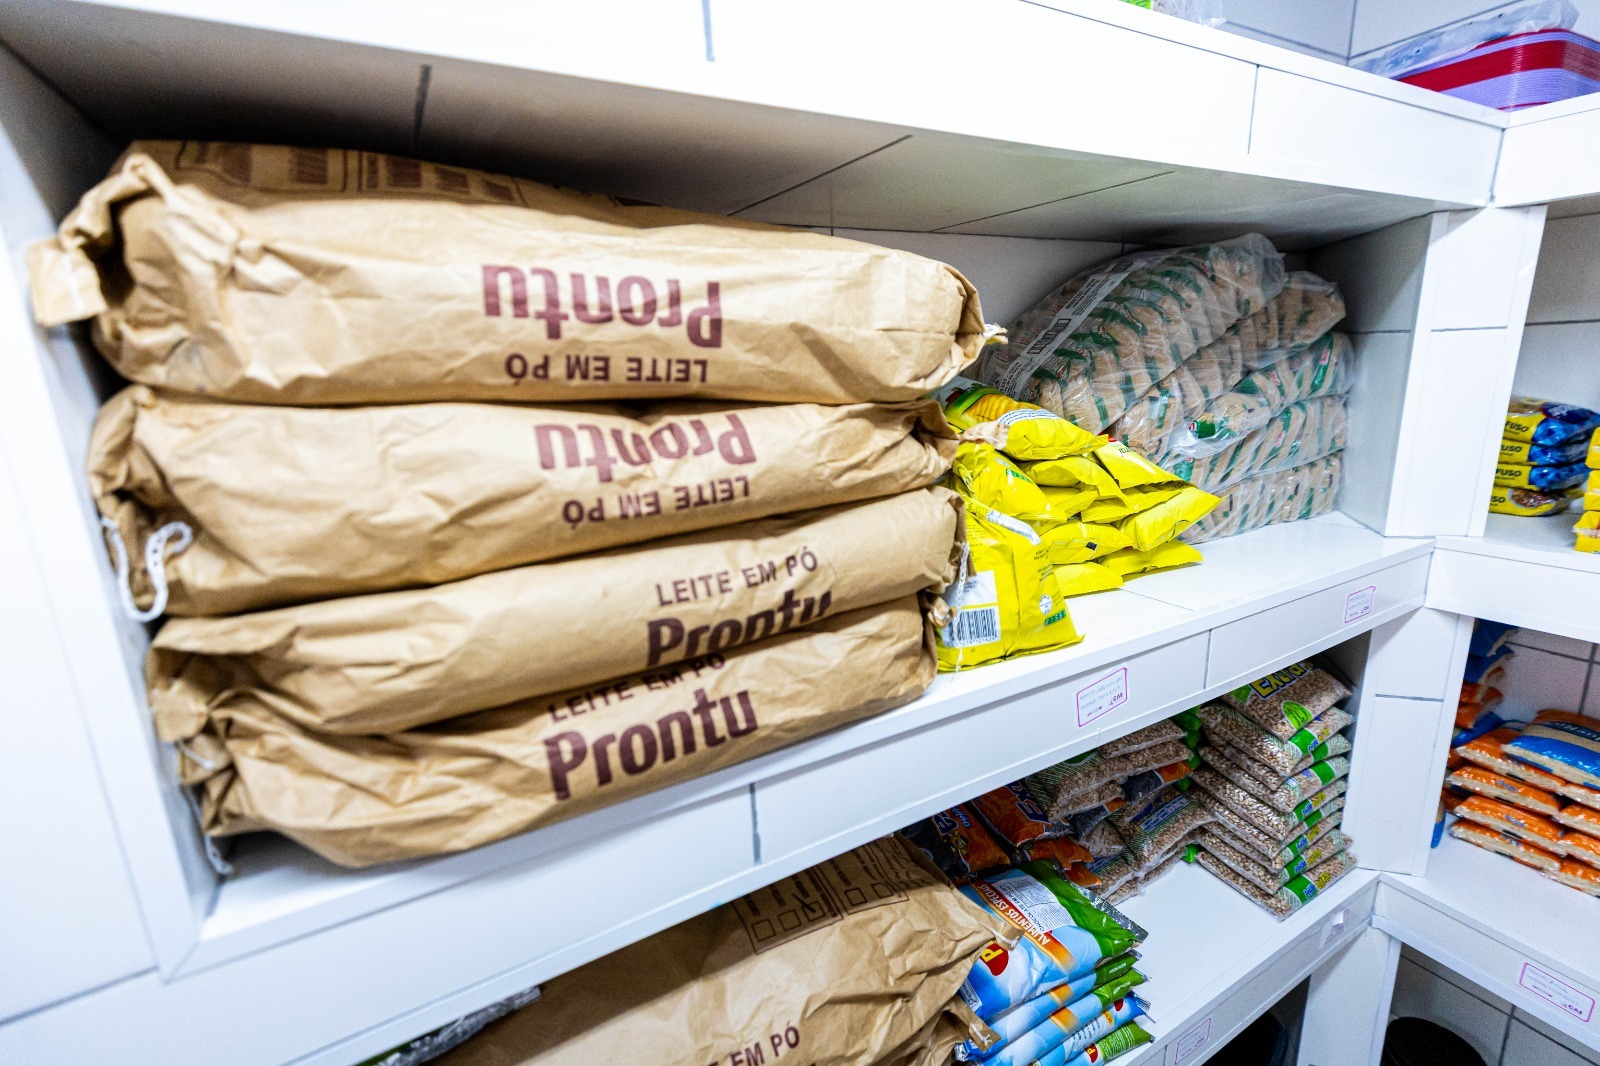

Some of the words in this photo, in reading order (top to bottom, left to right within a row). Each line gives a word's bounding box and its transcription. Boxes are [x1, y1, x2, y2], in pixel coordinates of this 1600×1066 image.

[482, 264, 723, 349] Prontu
[505, 353, 549, 386] PÓ
[566, 354, 610, 381] EM
[627, 356, 708, 383] LEITE
[533, 414, 757, 483] Prontu
[618, 491, 661, 519] EM
[674, 476, 750, 511] LEITE
[562, 499, 605, 530] PÓ
[656, 571, 732, 607] LEITE
[742, 561, 776, 588] EM
[786, 546, 817, 577] PÓ
[647, 588, 832, 667] Prontu
[548, 681, 634, 722] LEITE
[640, 670, 684, 691] EM
[543, 688, 759, 801] Prontu
[1005, 909, 1051, 945] ALIMENTOS
[770, 1021, 800, 1058] PÓ
